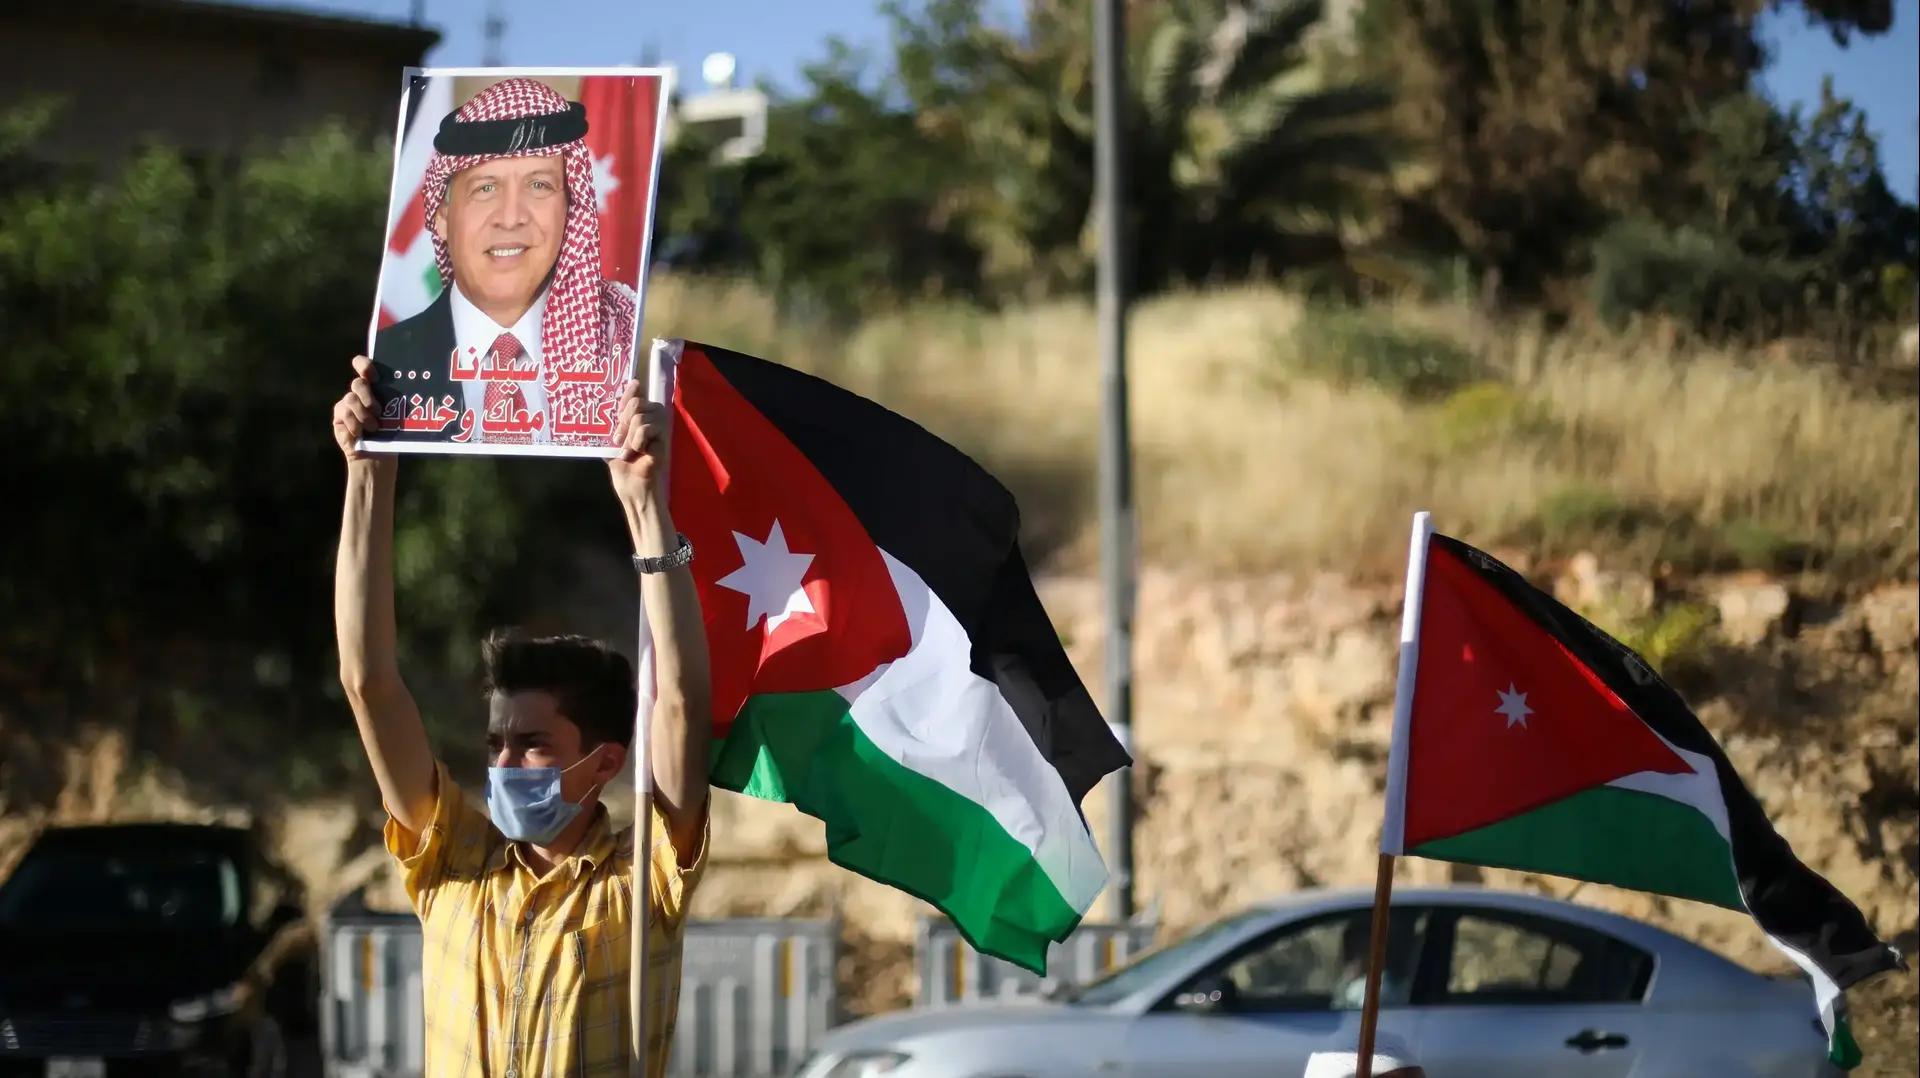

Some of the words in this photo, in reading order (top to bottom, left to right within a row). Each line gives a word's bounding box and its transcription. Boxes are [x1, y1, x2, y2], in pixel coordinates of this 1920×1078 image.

[450, 346, 541, 394] سيدنا
[543, 343, 622, 398] أبشر
[482, 398, 545, 434] معك
